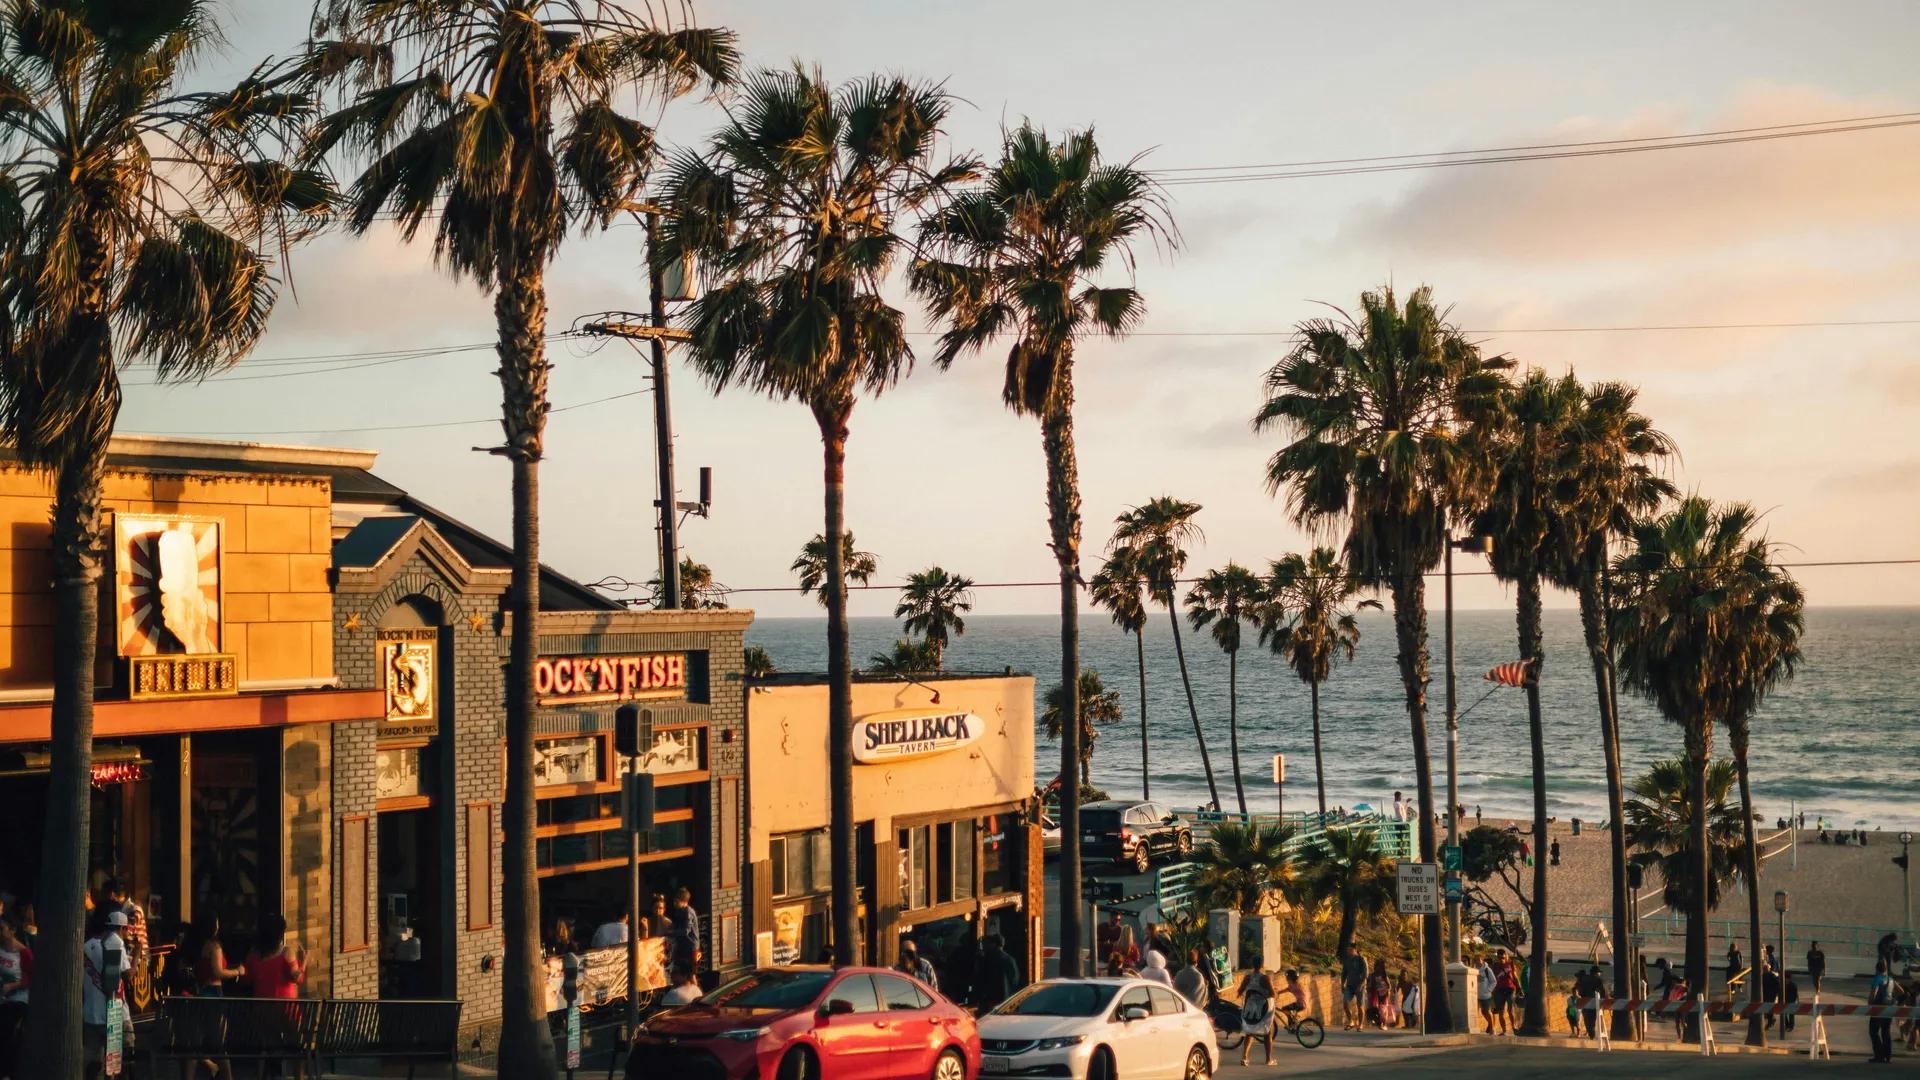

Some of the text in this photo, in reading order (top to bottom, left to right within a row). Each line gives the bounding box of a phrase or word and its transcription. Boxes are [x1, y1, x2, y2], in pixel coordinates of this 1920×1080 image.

[376, 629, 436, 641] ROCK'N FISH
[140, 661, 233, 693] BREWCO
[534, 655, 685, 700] OCK'N FISH
[865, 713, 970, 750] SHELLBACK
[899, 741, 936, 754] TAVERN
[1411, 866, 1423, 874] NO
[1401, 876, 1435, 884] TRUCKS OR
[1405, 894, 1431, 902] WEST OF
